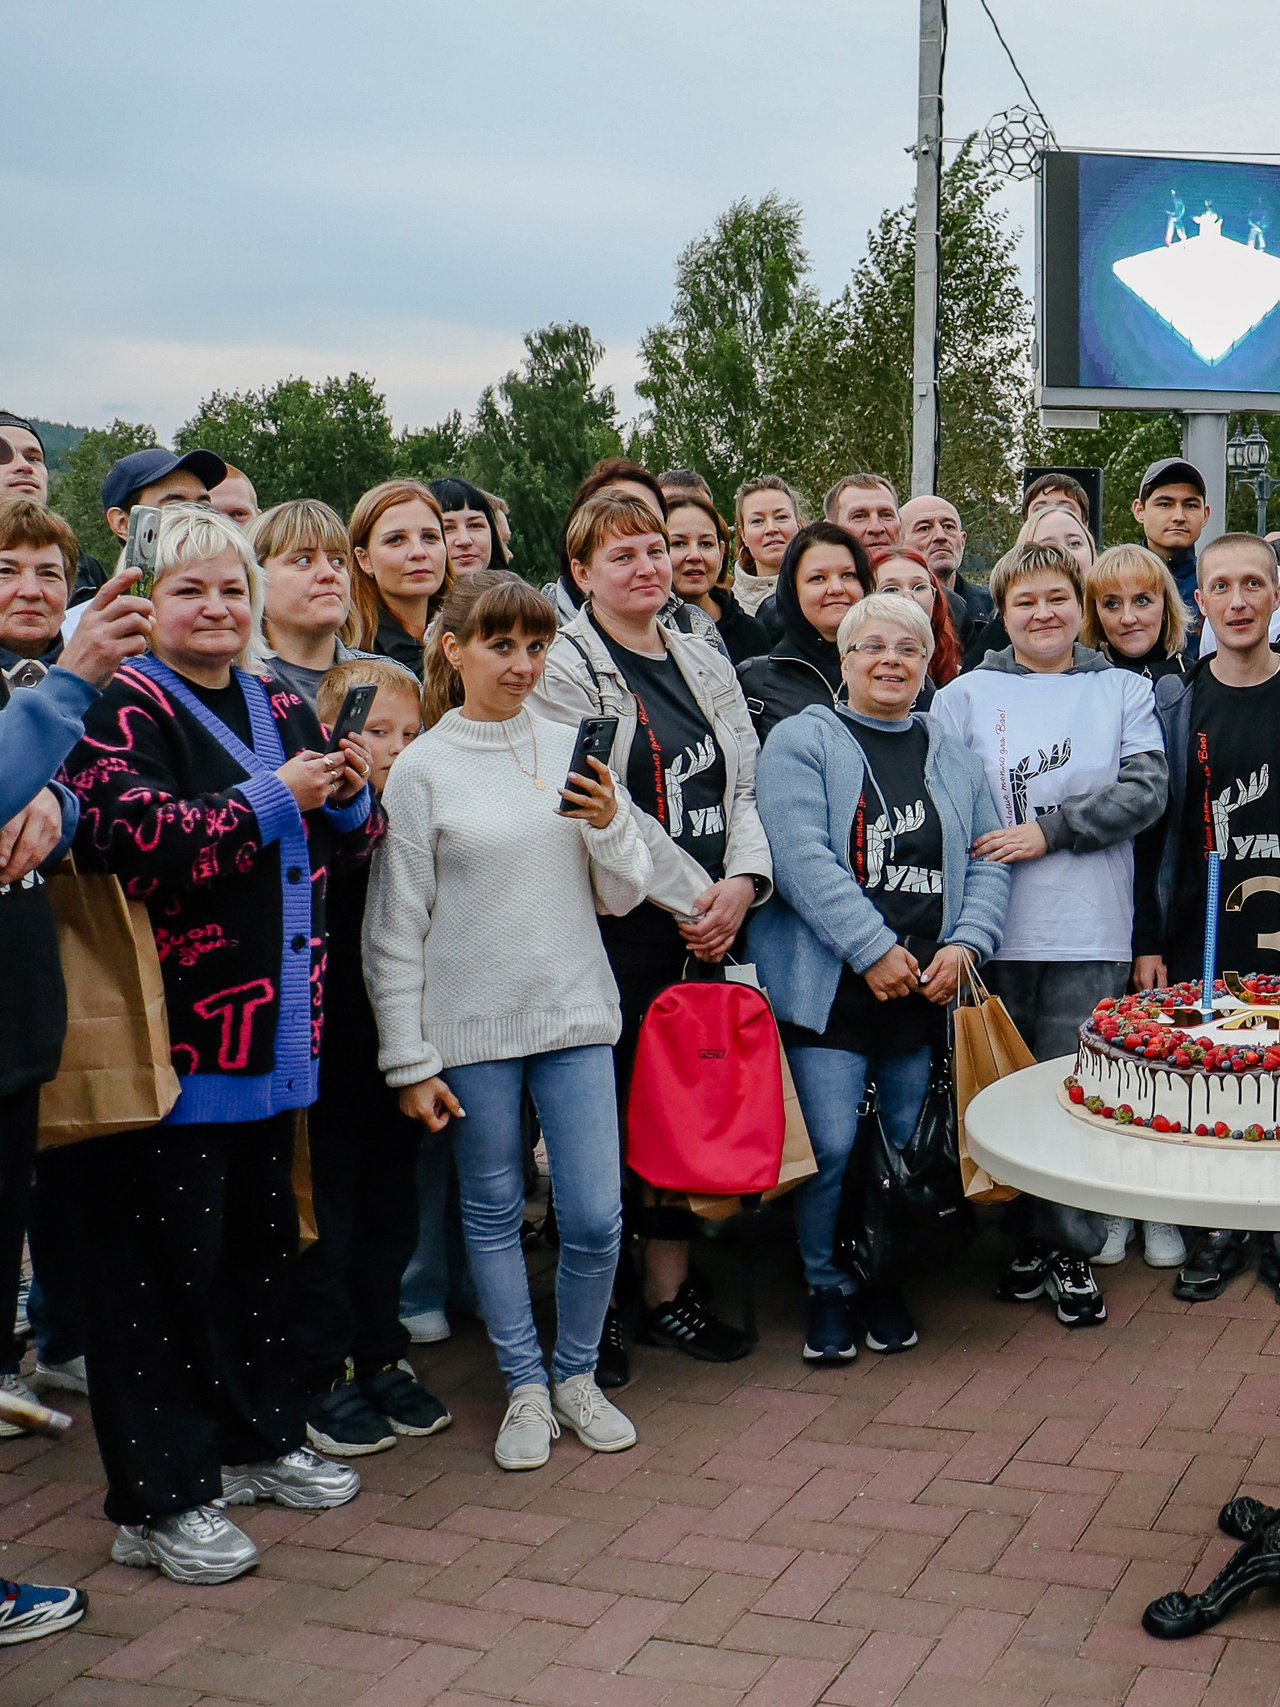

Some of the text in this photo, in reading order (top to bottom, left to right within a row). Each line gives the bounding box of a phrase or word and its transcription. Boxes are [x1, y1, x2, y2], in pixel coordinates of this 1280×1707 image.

[998, 737, 1008, 755] для
[999, 757, 1009, 791] тепло
[655, 797, 665, 825] аше
[687, 804, 725, 838] УМ
[883, 865, 943, 894] УМТ
